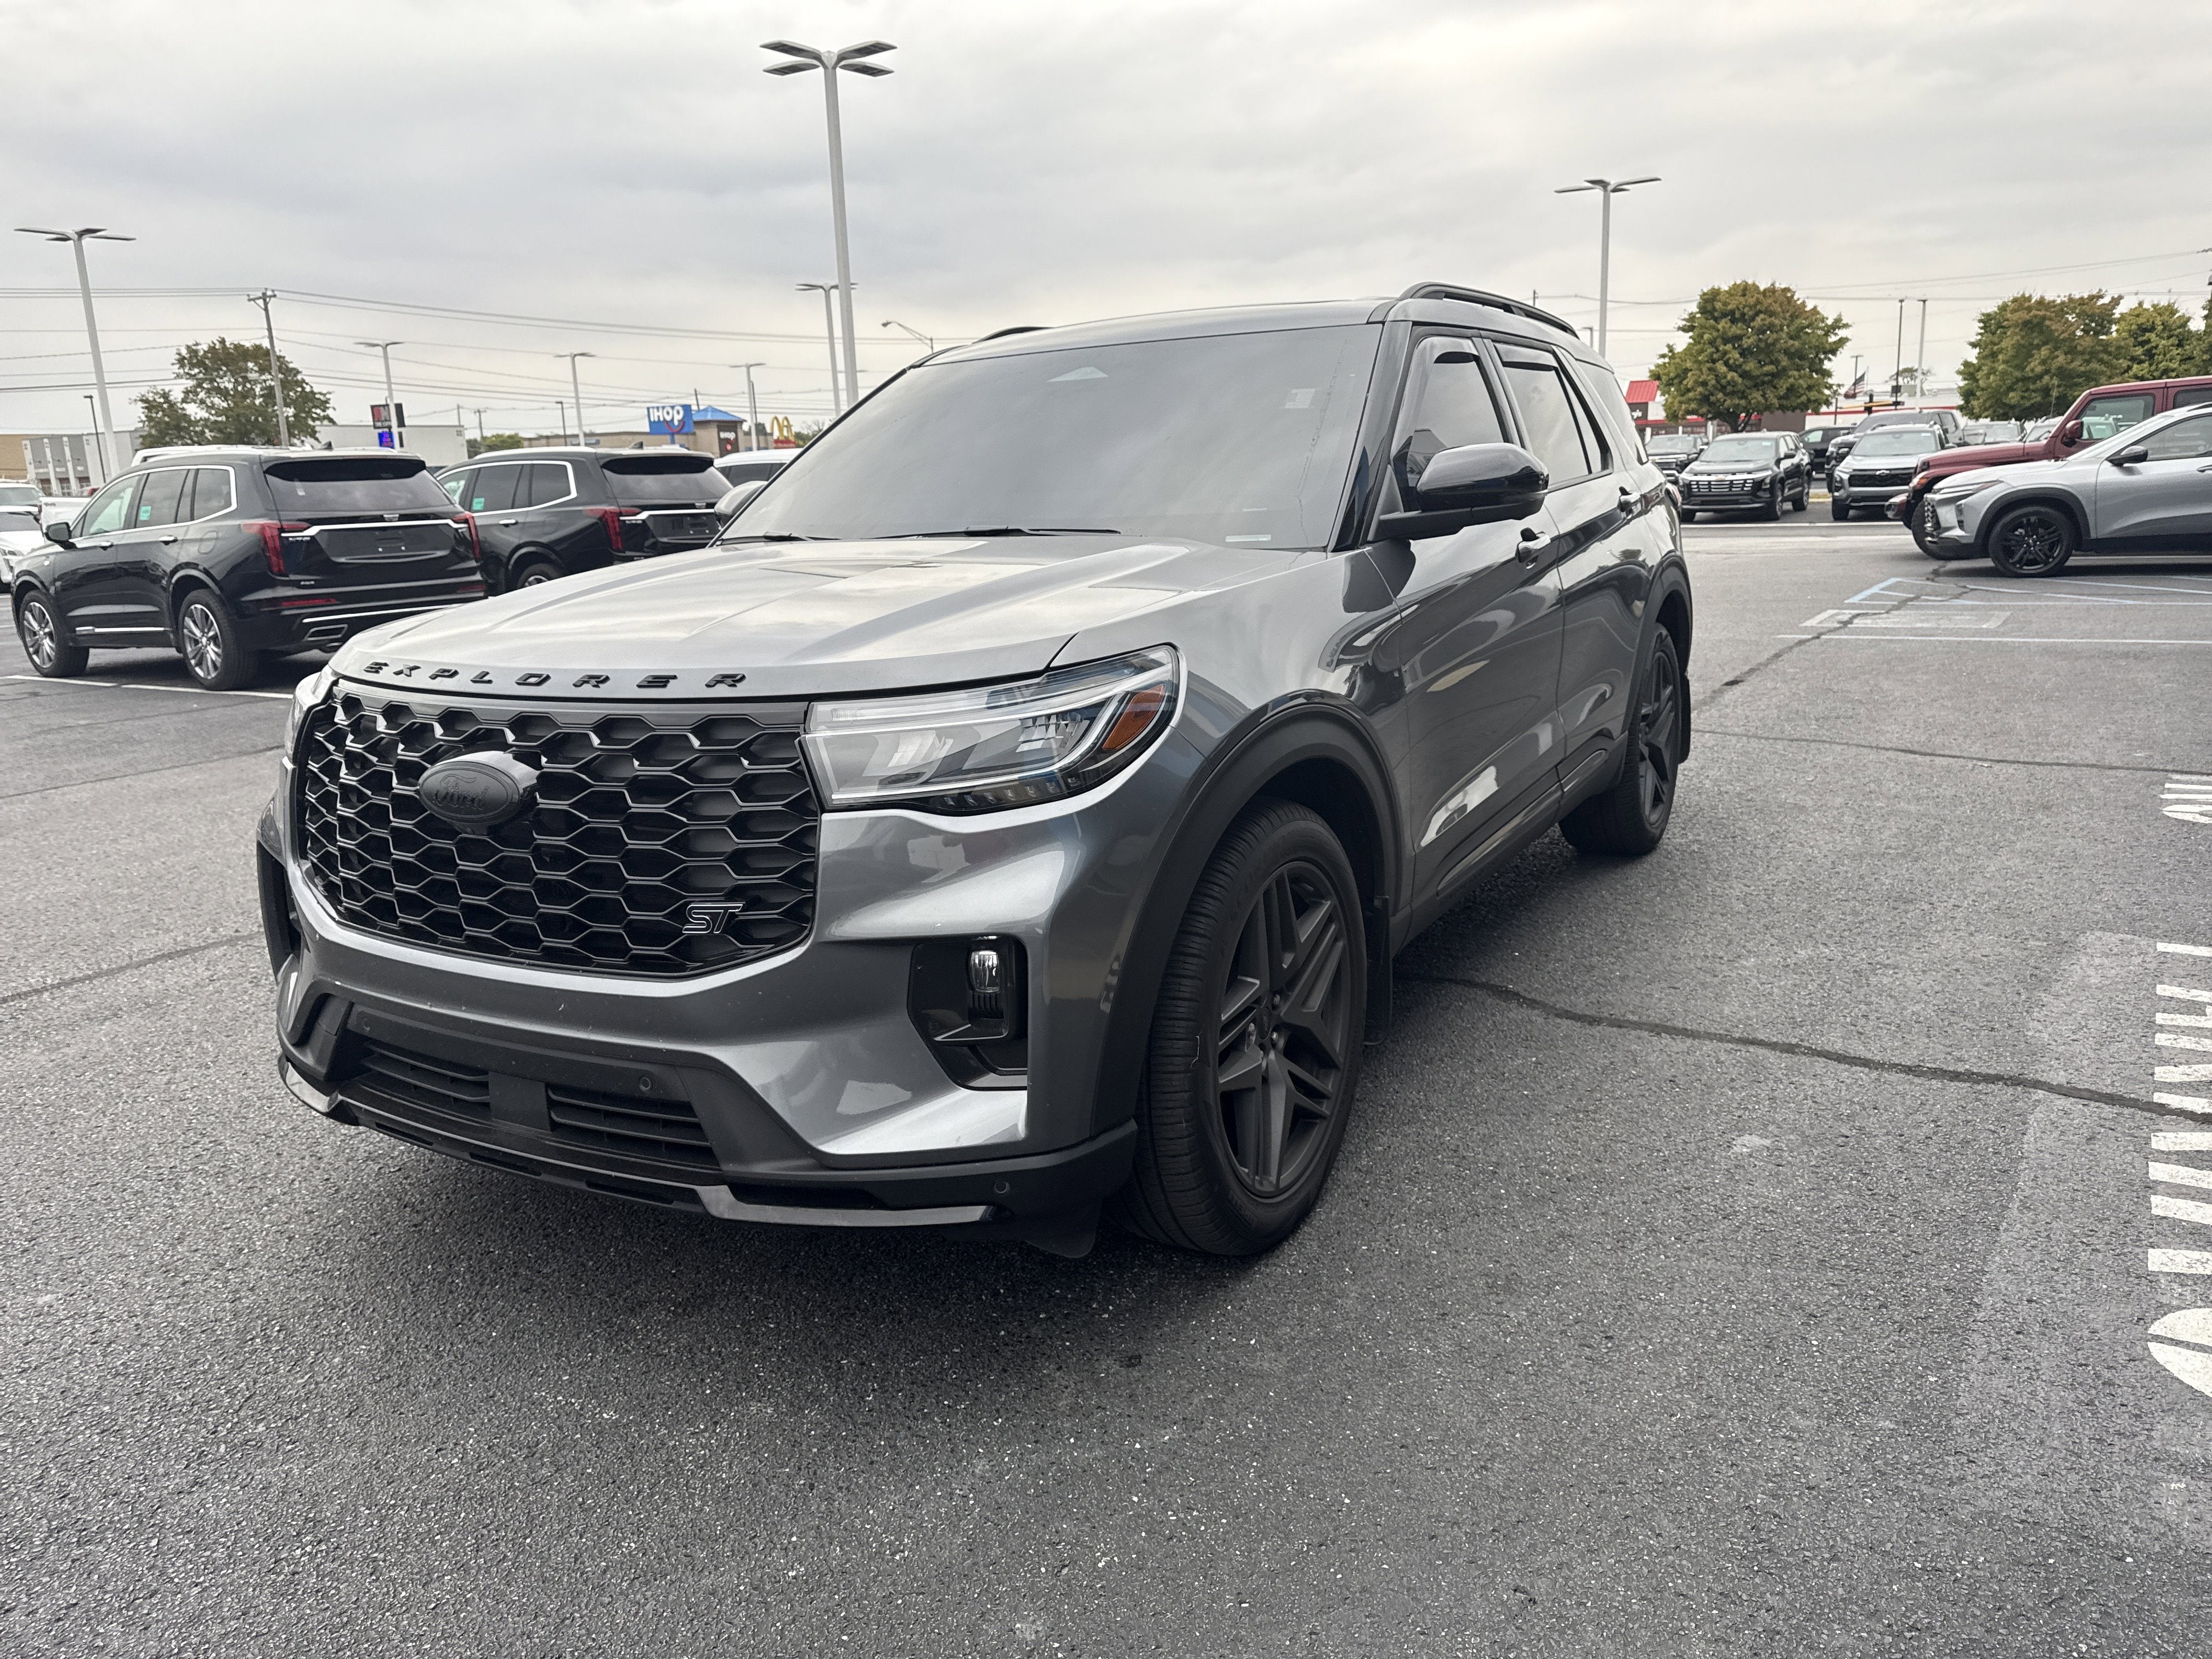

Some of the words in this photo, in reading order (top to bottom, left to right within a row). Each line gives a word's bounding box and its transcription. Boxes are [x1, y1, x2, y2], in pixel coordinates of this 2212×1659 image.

[649, 406, 684, 426] IHOP
[363, 661, 747, 689] EXPLORER
[432, 773, 490, 810] Ford
[682, 902, 744, 934] ST
